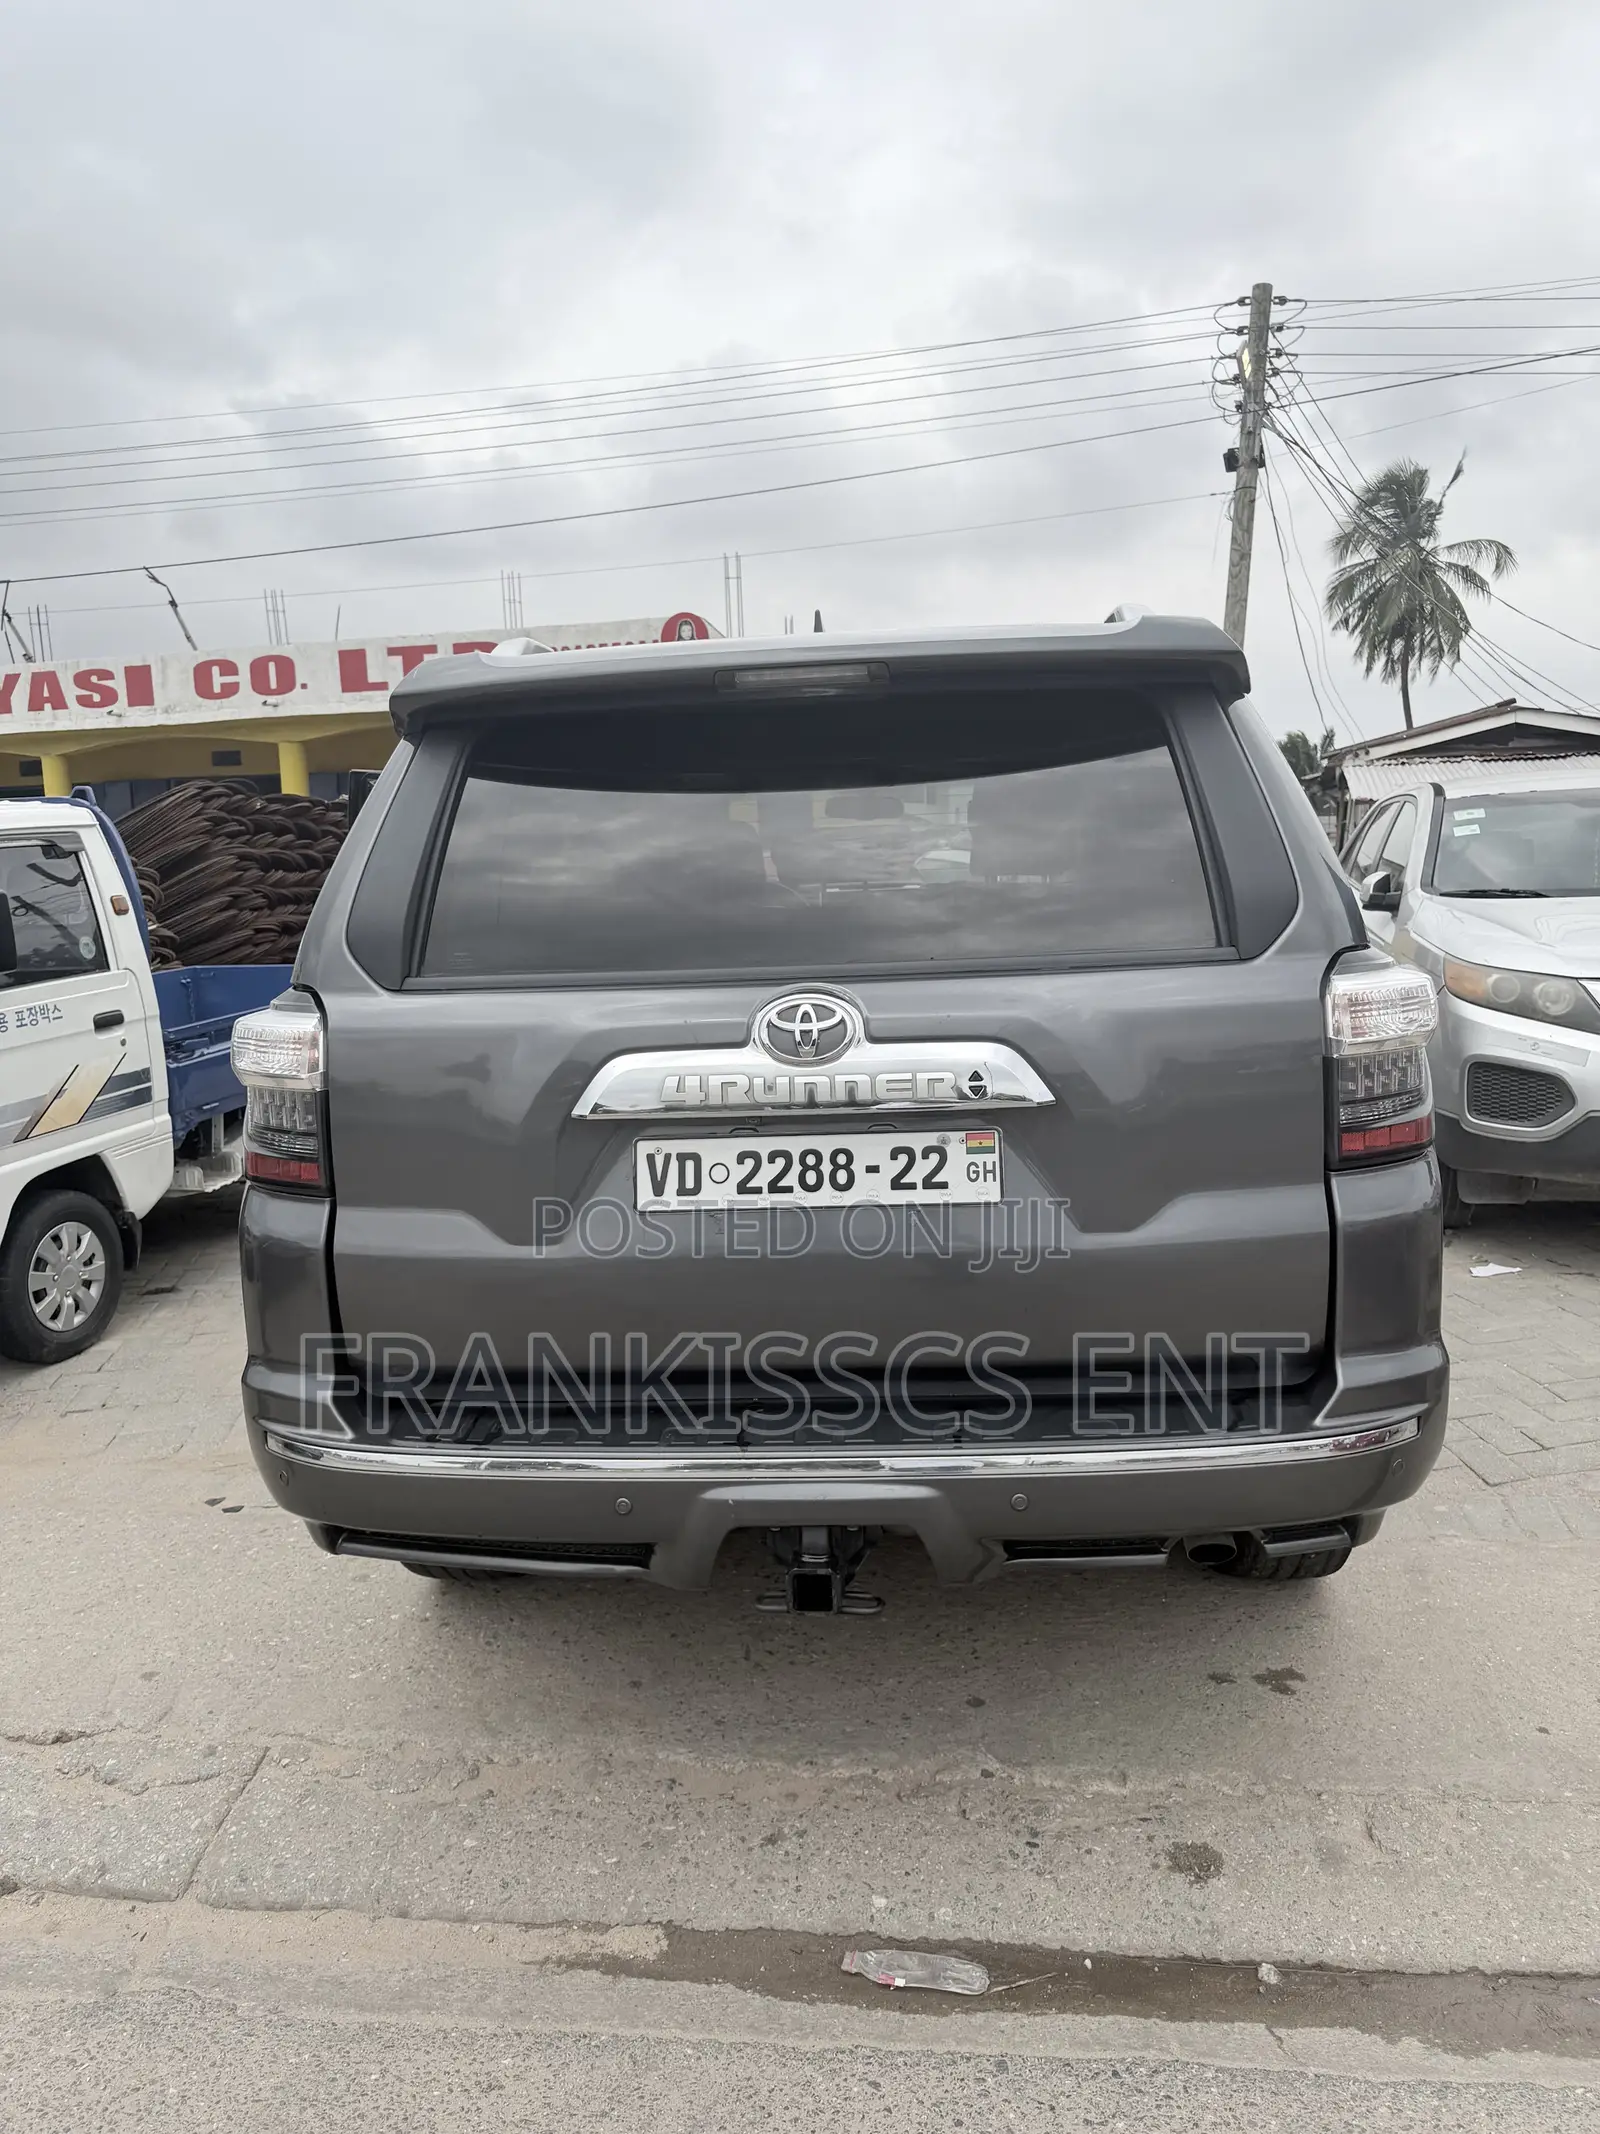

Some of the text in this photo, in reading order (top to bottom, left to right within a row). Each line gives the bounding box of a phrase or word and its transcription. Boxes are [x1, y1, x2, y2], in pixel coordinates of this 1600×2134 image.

[193, 654, 308, 700] CO.
[338, 641, 499, 693] LT
[15, 1003, 64, 1028] 포장박스
[646, 1151, 702, 1197] VD
[966, 1161, 997, 1183] GH
